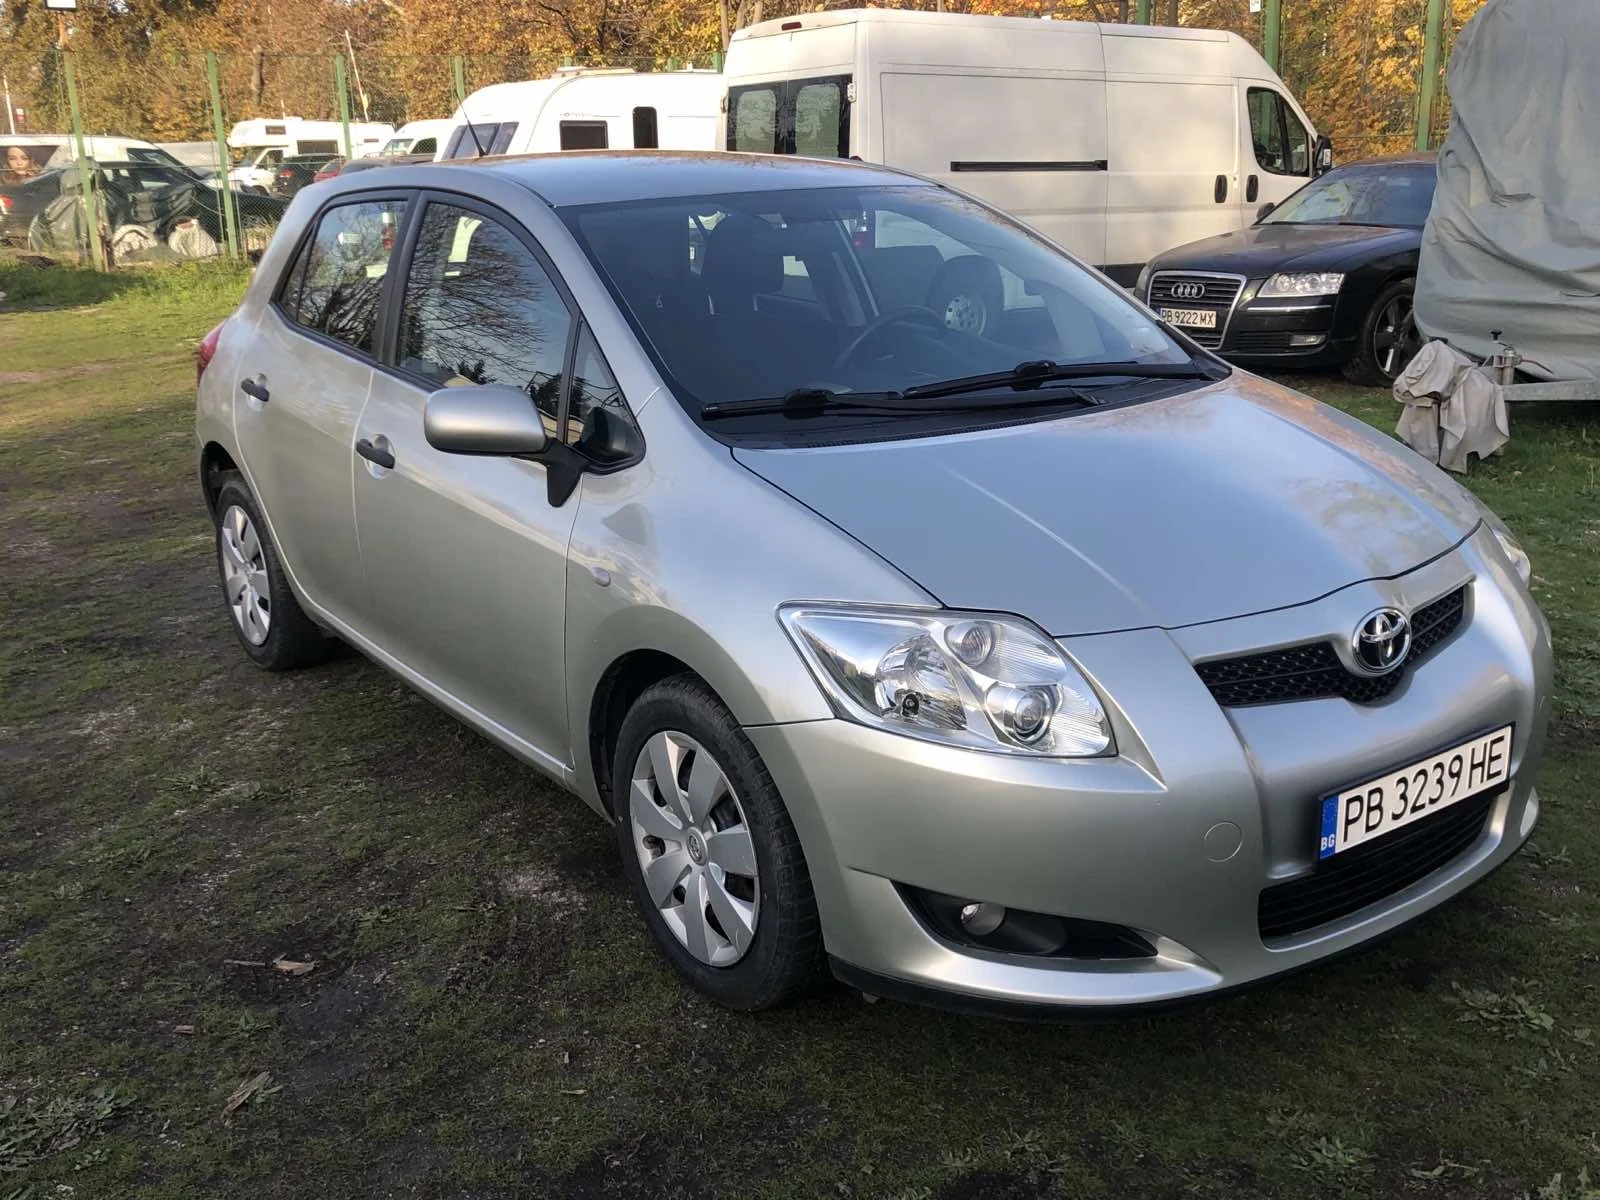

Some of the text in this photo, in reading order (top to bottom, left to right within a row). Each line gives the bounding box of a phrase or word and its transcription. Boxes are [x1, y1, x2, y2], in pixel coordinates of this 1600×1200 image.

[1174, 311, 1198, 325] 9222
[1200, 312, 1214, 326] MX
[1343, 735, 1505, 843] PB 3239 HE
[1320, 833, 1335, 851] BG
